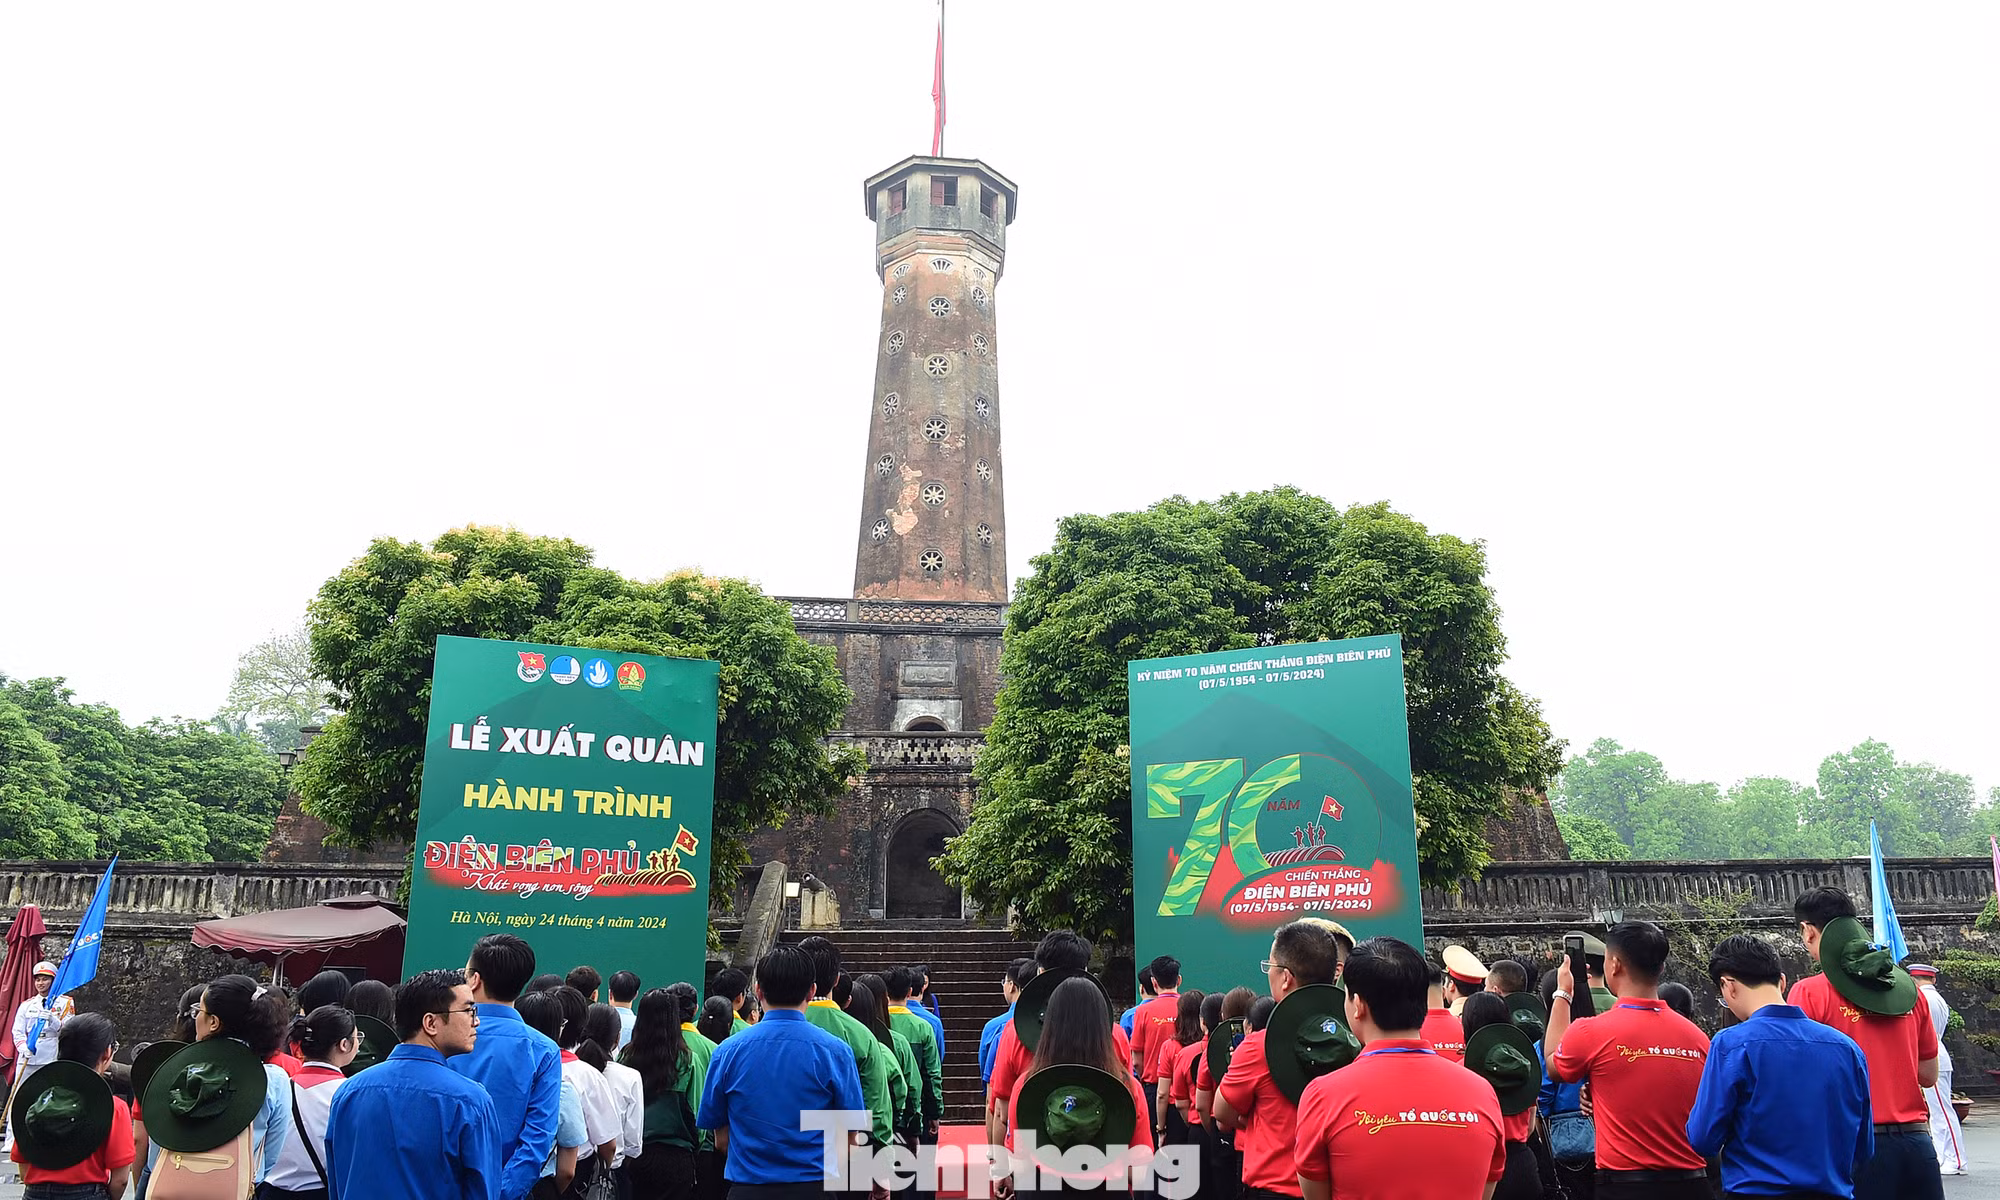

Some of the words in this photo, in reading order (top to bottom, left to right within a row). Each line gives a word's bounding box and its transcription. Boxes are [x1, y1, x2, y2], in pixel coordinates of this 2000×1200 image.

[1153, 669, 1182, 681] NIỆM
[1185, 667, 1198, 677] 70
[1200, 663, 1227, 676] NĂM
[1229, 658, 1262, 674] CHIẾN
[1264, 654, 1303, 670] THẮNG
[1306, 652, 1334, 666] ĐIỆN
[1336, 650, 1364, 663] BIÊN
[1367, 646, 1392, 660] PHỦ
[1199, 676, 1256, 691] (07/5/1954
[1265, 669, 1325, 683] 07/5/2024)
[450, 715, 491, 752] LỄ
[498, 723, 595, 758] XUẤT
[604, 735, 704, 767] QUÂN
[463, 778, 564, 813] HÀNH
[573, 785, 672, 819] TRÌNH
[1266, 799, 1301, 812] NĂM
[423, 835, 499, 877] ĐIỆN
[505, 838, 575, 874] BIÊN
[580, 840, 641, 876] PHỦ
[1285, 868, 1319, 882] CHIẾN
[1321, 868, 1361, 881] THẮNG
[511, 881, 541, 900] vọng
[541, 881, 564, 894] non
[565, 881, 595, 902] sông
[1243, 882, 1287, 904] ĐIỆN
[1289, 881, 1330, 899] BIÊN
[1334, 878, 1372, 897] PHỦ
[1303, 899, 1372, 912] 07/5/2024)
[450, 910, 471, 924] Hà
[474, 909, 503, 927] Nội,
[506, 914, 536, 928] ngày
[538, 914, 555, 926] 24
[557, 913, 593, 929] tháng
[596, 916, 605, 927] 4
[607, 915, 635, 928] năm
[637, 916, 667, 929] 2024
[1648, 1045, 1661, 1055] TỔ
[1662, 1047, 1687, 1057] QUỐC
[1398, 1108, 1417, 1122] TỔ
[1419, 1108, 1457, 1122] QUỐC
[1457, 1110, 1479, 1123] TÔI
